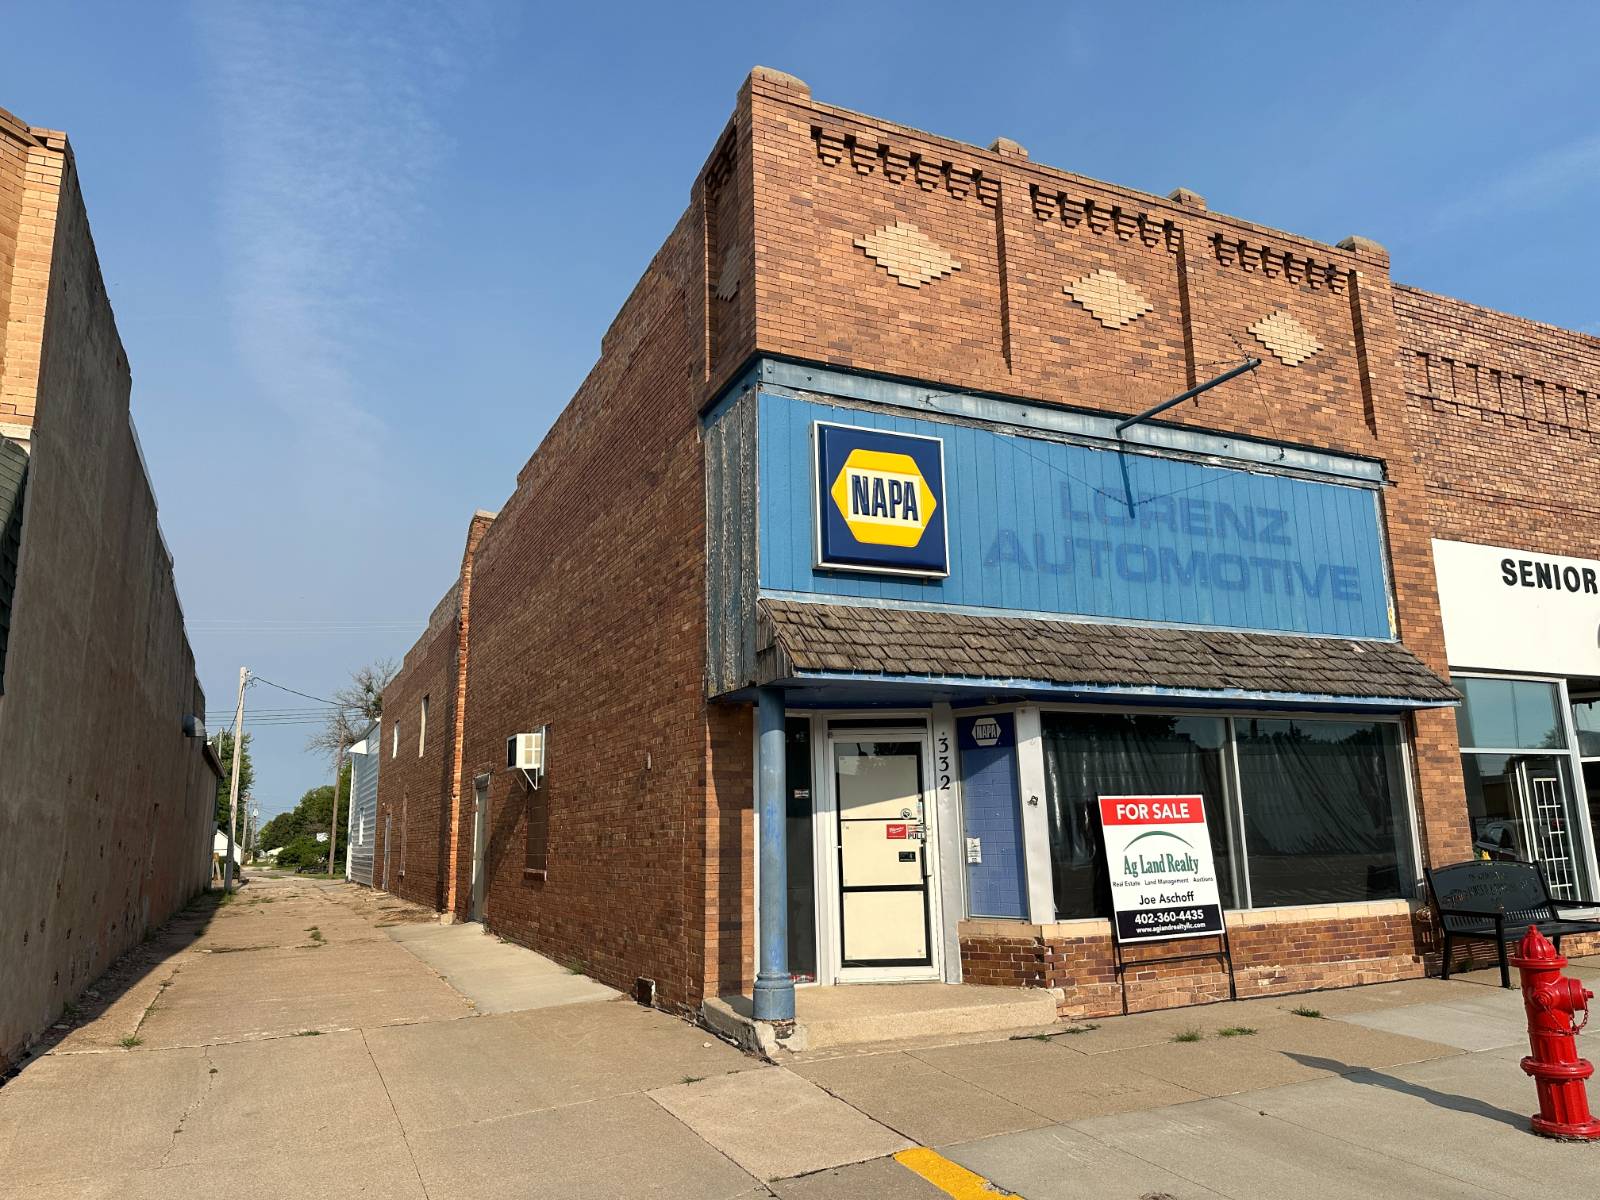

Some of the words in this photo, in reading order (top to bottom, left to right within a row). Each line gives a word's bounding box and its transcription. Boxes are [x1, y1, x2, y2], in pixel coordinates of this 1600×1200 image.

[851, 475, 918, 521] NAPA
[1059, 480, 1292, 547] LORENZ
[983, 528, 1362, 601] AUTOMOTIVE
[1501, 558, 1598, 594] SENIOR
[976, 724, 997, 739] NAPA
[938, 737, 951, 790] 332
[1116, 803, 1149, 820] FOR
[1152, 803, 1190, 819] SALE
[1124, 855, 1138, 877] Ag
[1139, 854, 1166, 874] Land
[1166, 853, 1199, 874] Realty
[1158, 878, 1189, 886] Management
[1139, 895, 1156, 905] Joe
[1160, 891, 1194, 904] Aschoff
[1135, 909, 1204, 924] 402-360-4435
